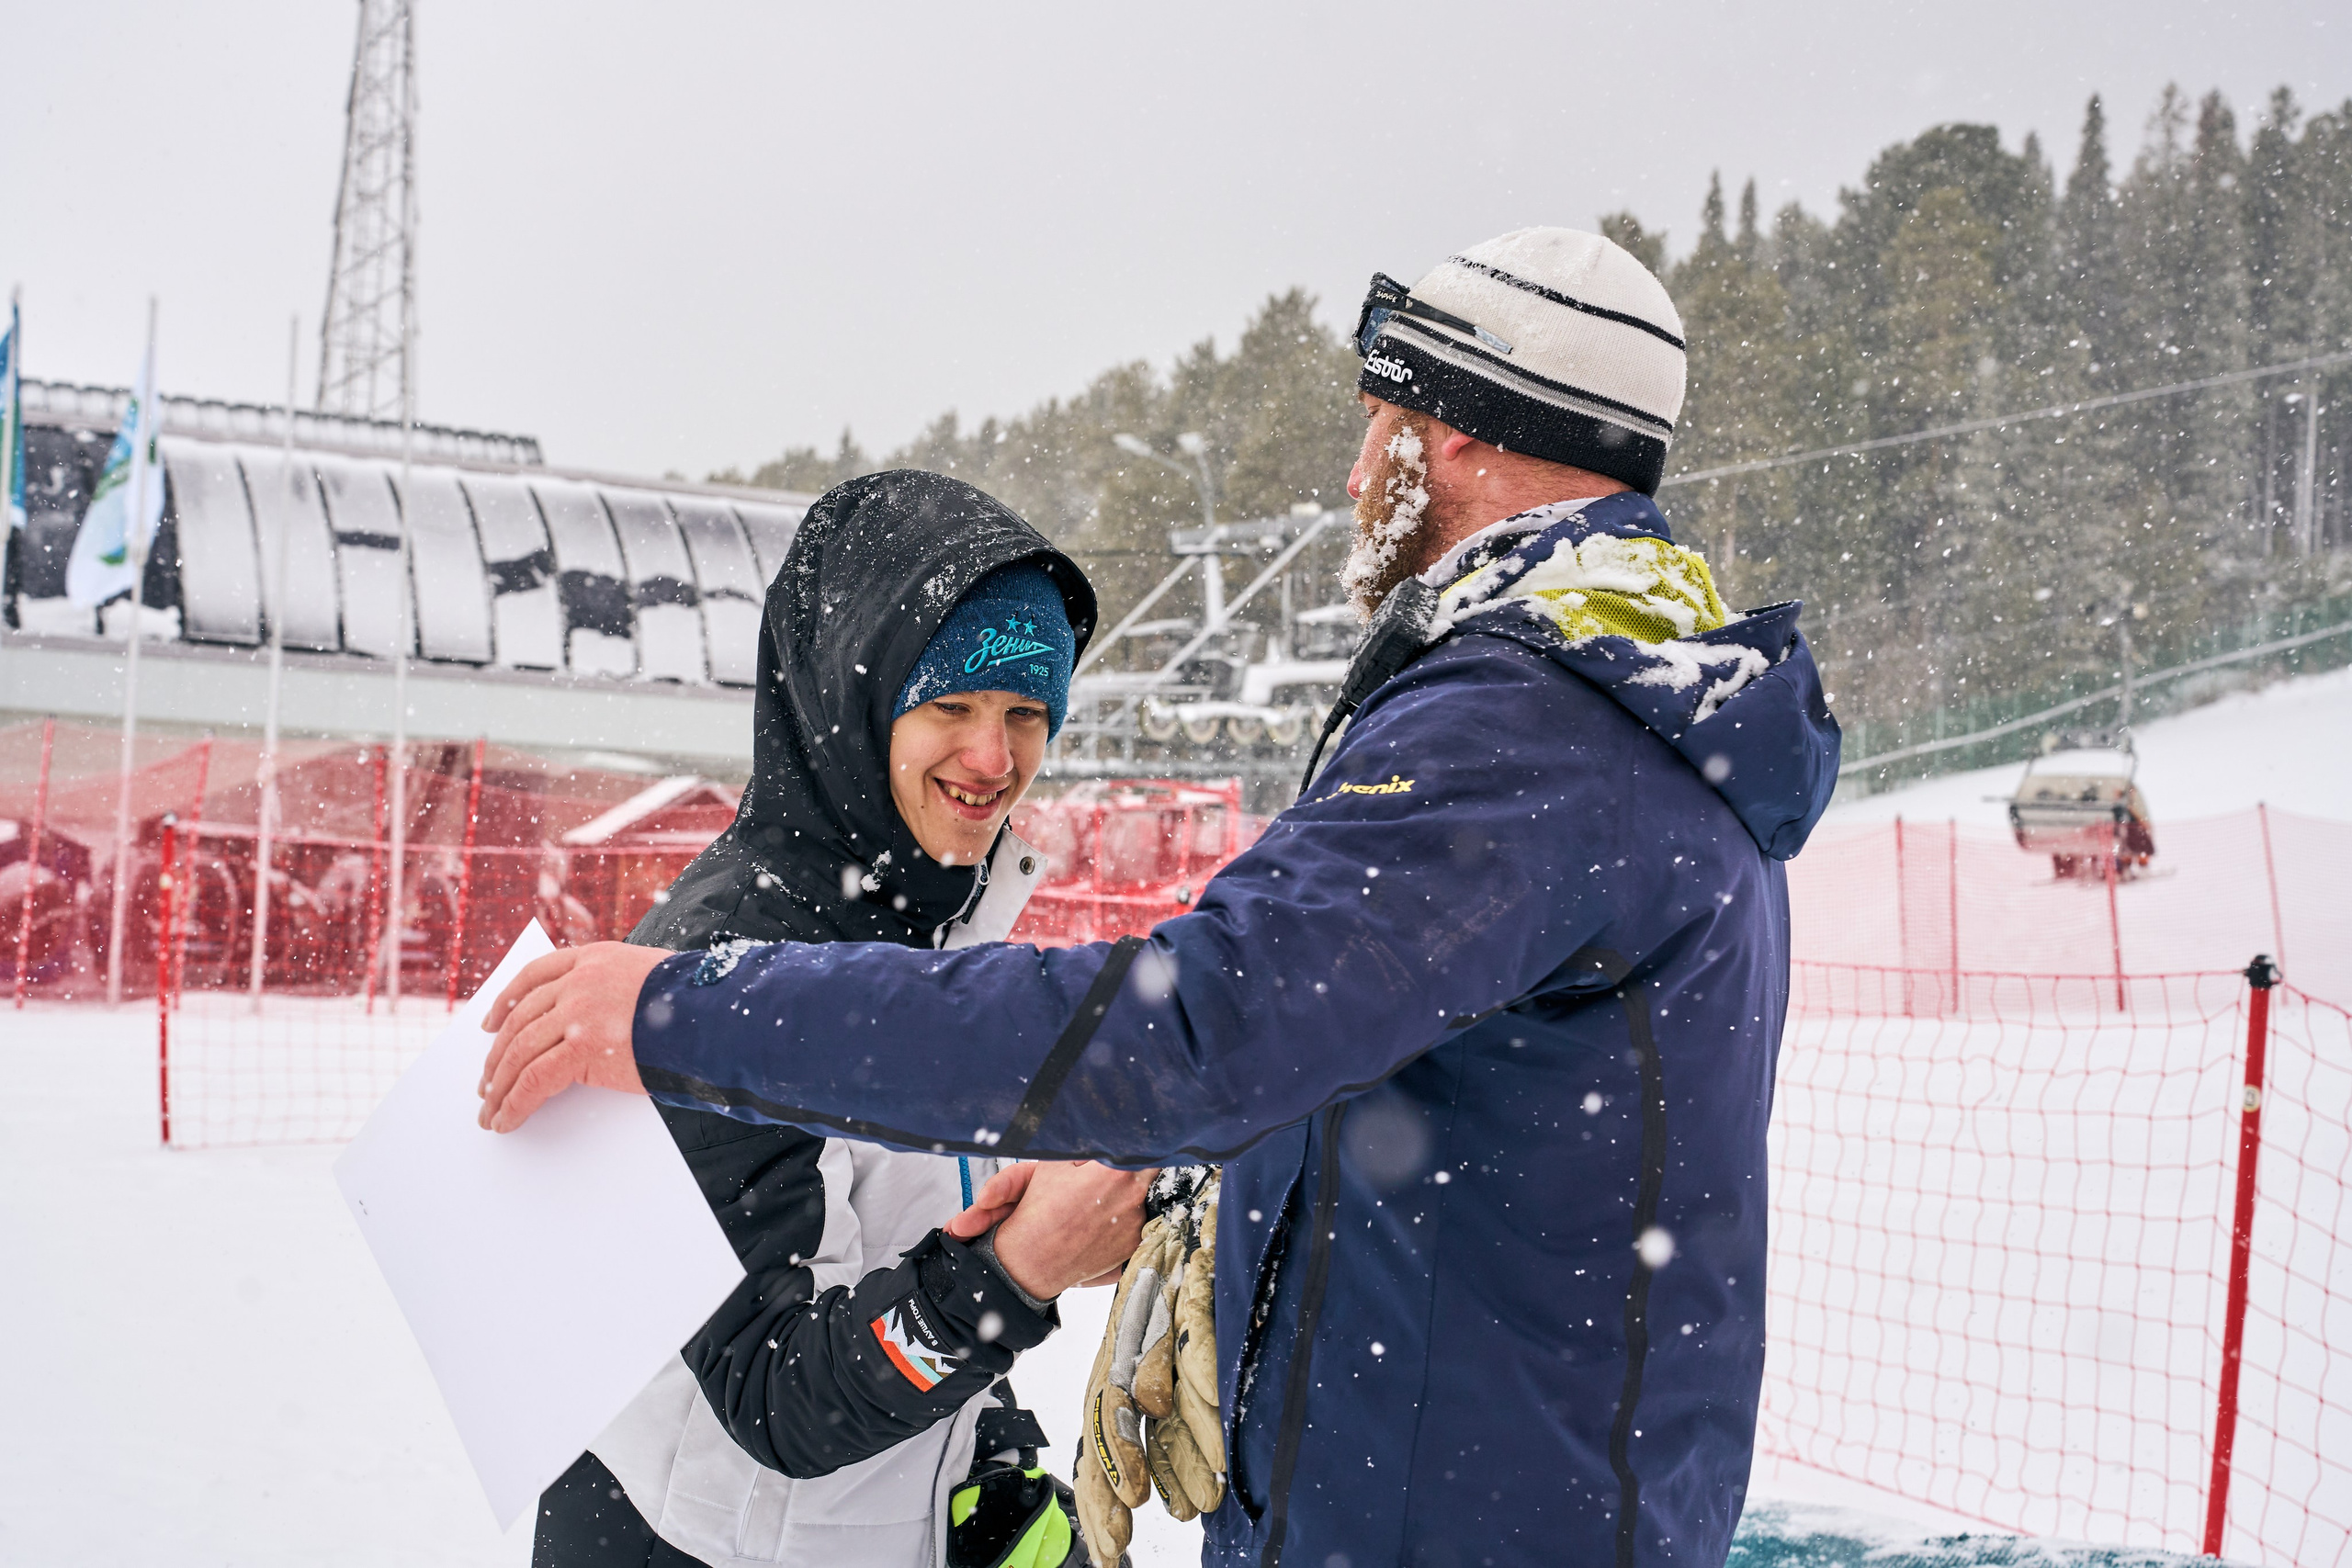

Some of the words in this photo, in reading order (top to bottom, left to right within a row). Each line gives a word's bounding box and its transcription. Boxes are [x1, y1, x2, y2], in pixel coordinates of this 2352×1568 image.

[1029, 663, 1049, 677] 1925
[1316, 774, 1416, 802] henix
[908, 1298, 922, 1320] ГОРЫ
[917, 1317, 935, 1340] ДУШЕ
